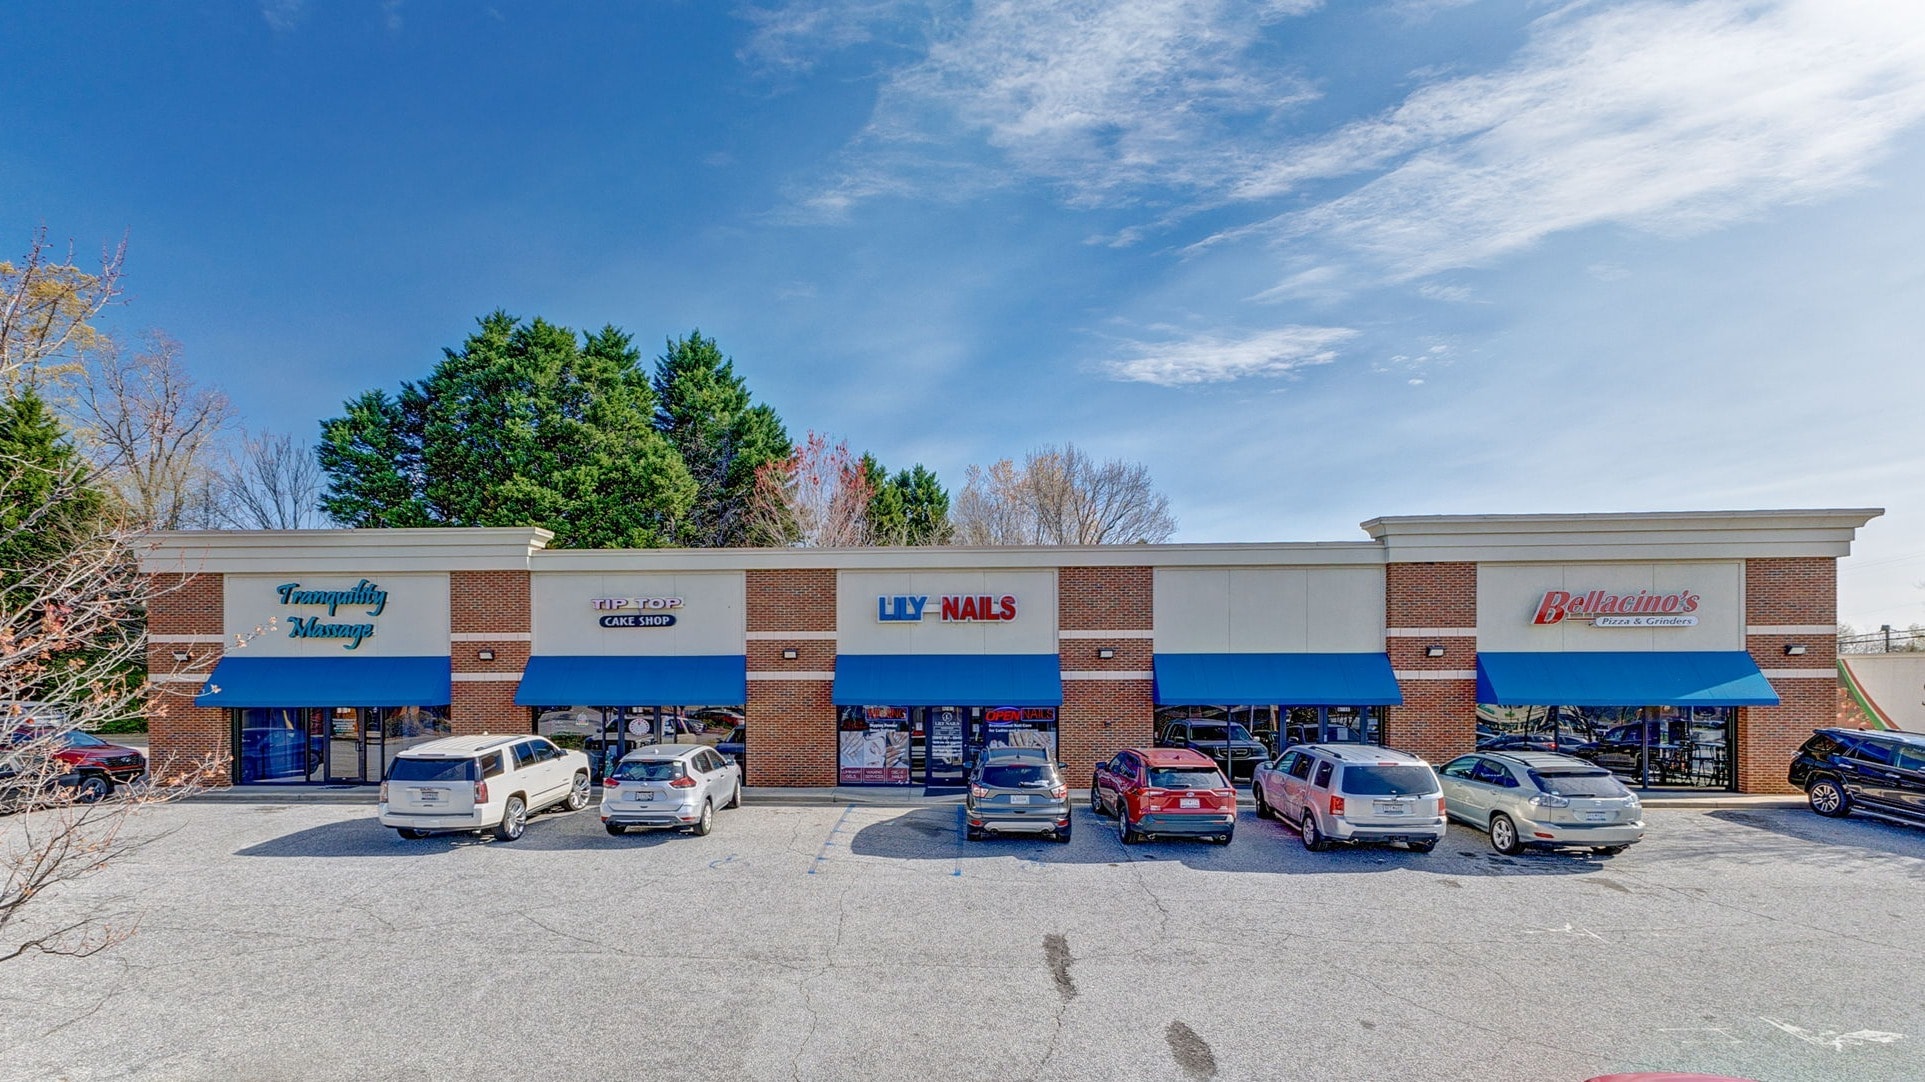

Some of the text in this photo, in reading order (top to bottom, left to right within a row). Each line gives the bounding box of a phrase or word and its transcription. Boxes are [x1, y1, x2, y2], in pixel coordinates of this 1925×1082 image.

[276, 579, 388, 616] Tranquility
[591, 598, 682, 610] TIP TOP
[878, 594, 1018, 622] LILY NAILS
[1531, 589, 1700, 625] Bellacino's
[604, 616, 670, 626] CAKE SHOP
[1602, 617, 1692, 625] Pizza & Grinders
[287, 616, 375, 650] Massage
[985, 710, 1020, 721] OPEN
[1022, 708, 1053, 719] NAILS
